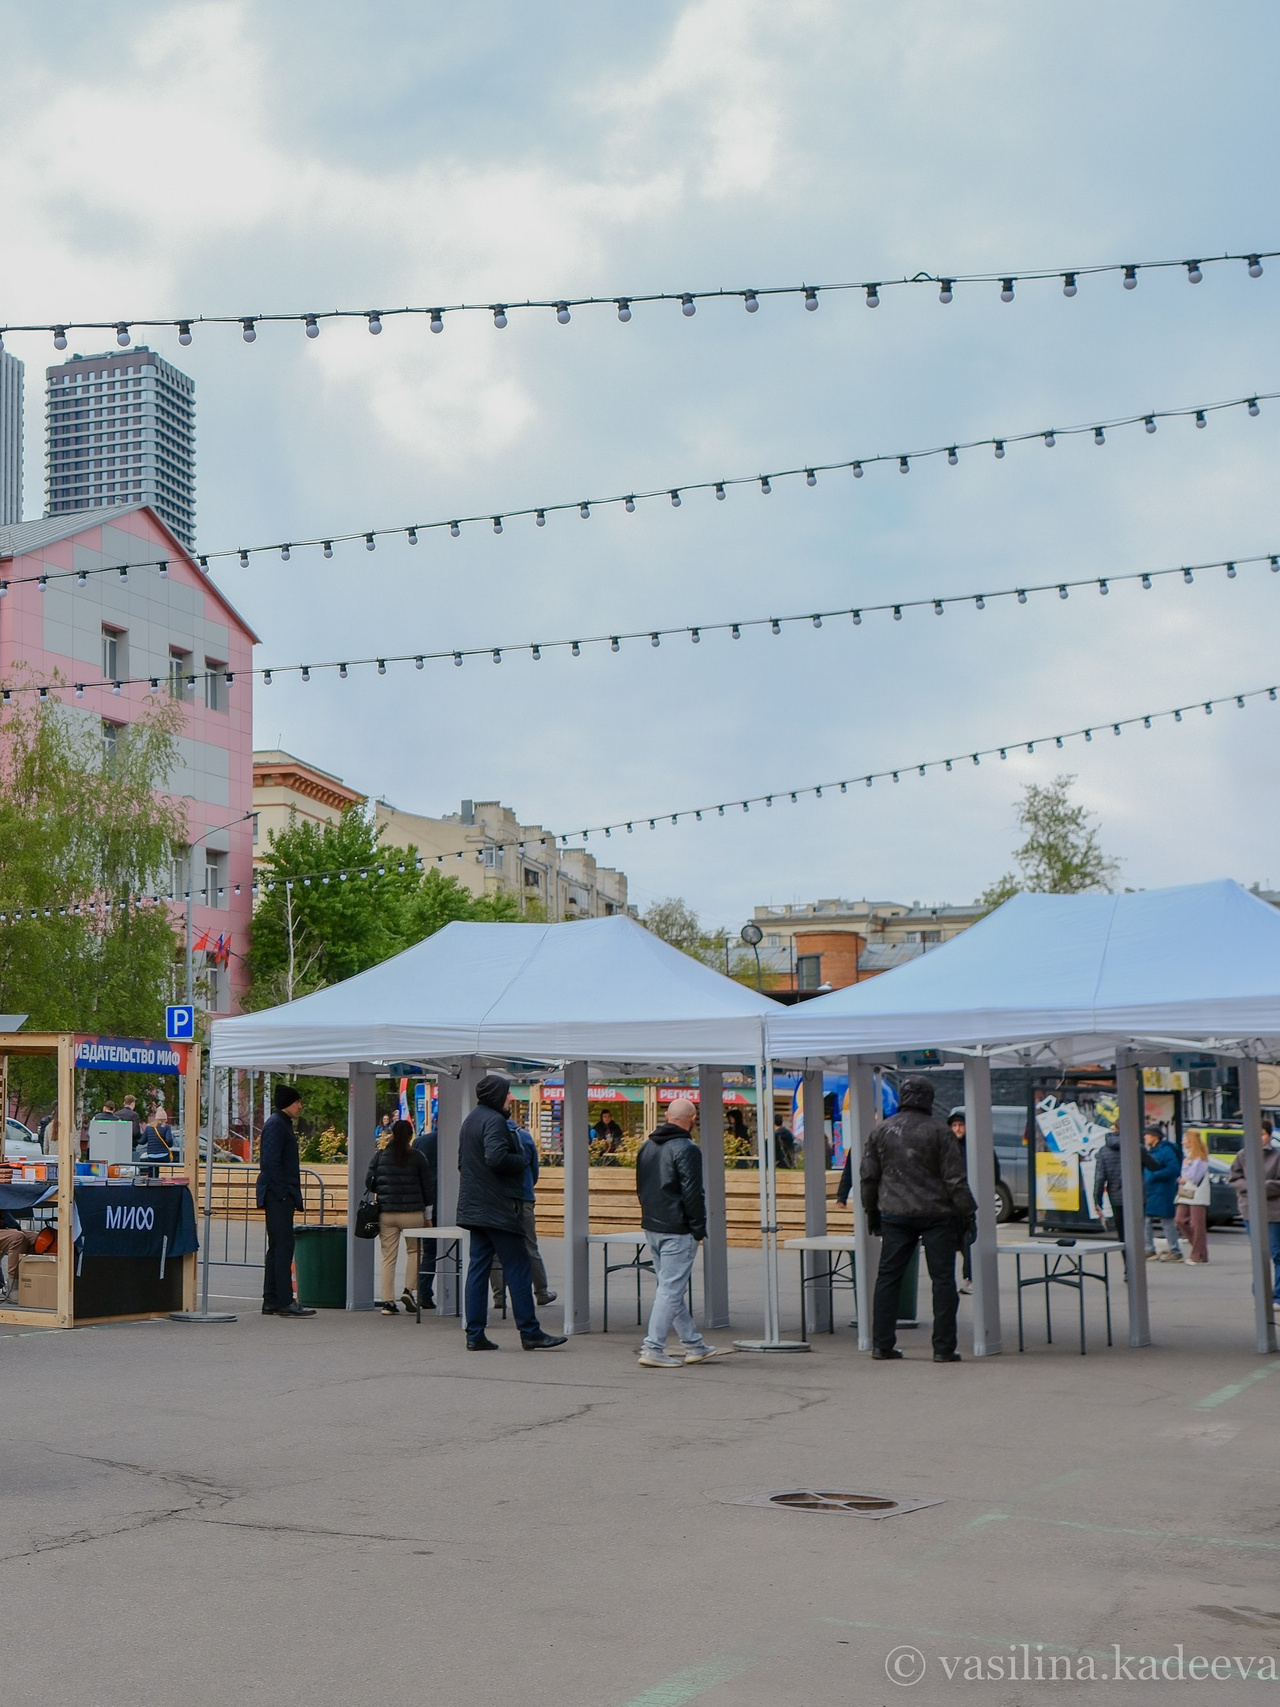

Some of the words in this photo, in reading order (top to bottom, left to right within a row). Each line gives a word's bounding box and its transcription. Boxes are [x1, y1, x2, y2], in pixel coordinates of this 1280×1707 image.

[75, 1043, 155, 1063] ИЗДАТЕЛЬСТВО
[157, 1050, 181, 1066] МИФ
[543, 1088, 616, 1099] РЕГАЦИЯ
[660, 1089, 736, 1100] РЕГИСТИЯ
